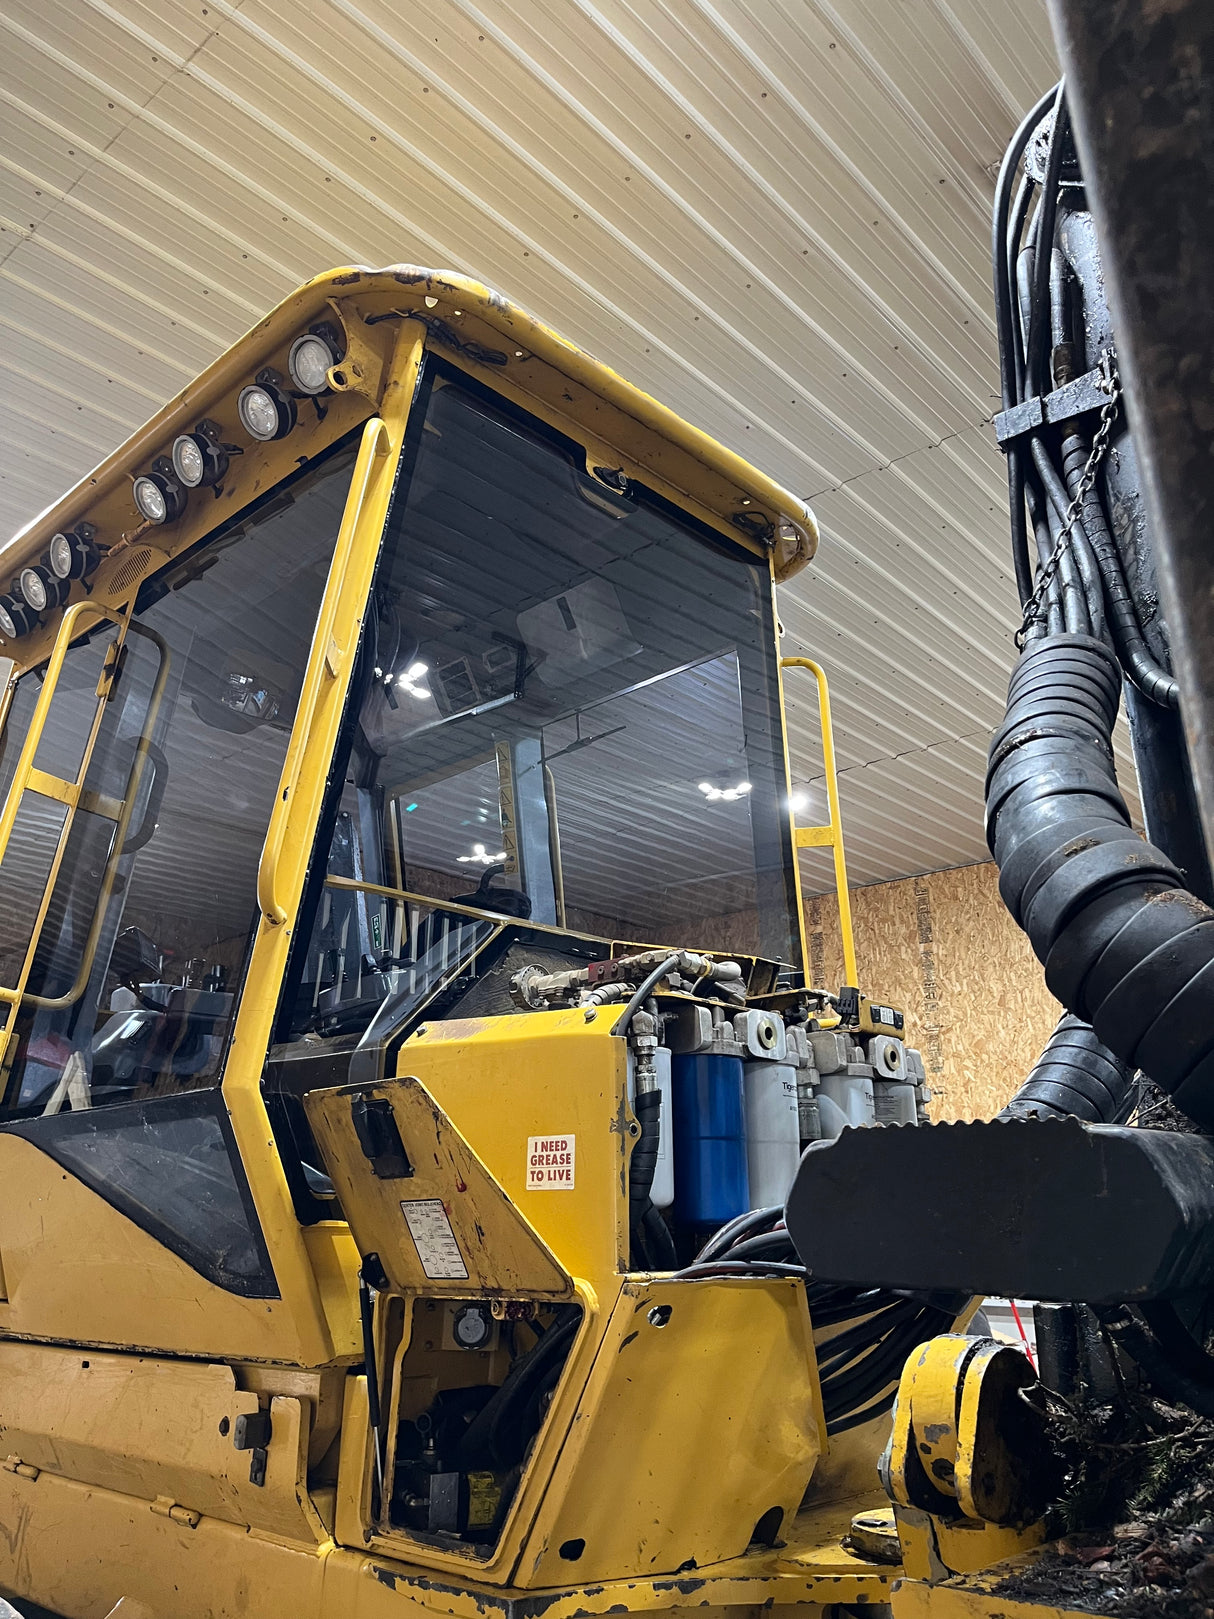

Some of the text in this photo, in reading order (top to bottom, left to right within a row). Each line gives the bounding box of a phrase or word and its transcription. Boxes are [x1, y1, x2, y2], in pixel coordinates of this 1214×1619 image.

[534, 1139, 568, 1153] I NEED
[530, 1153, 572, 1166] GREASE
[530, 1169, 572, 1182] TO LIVE
